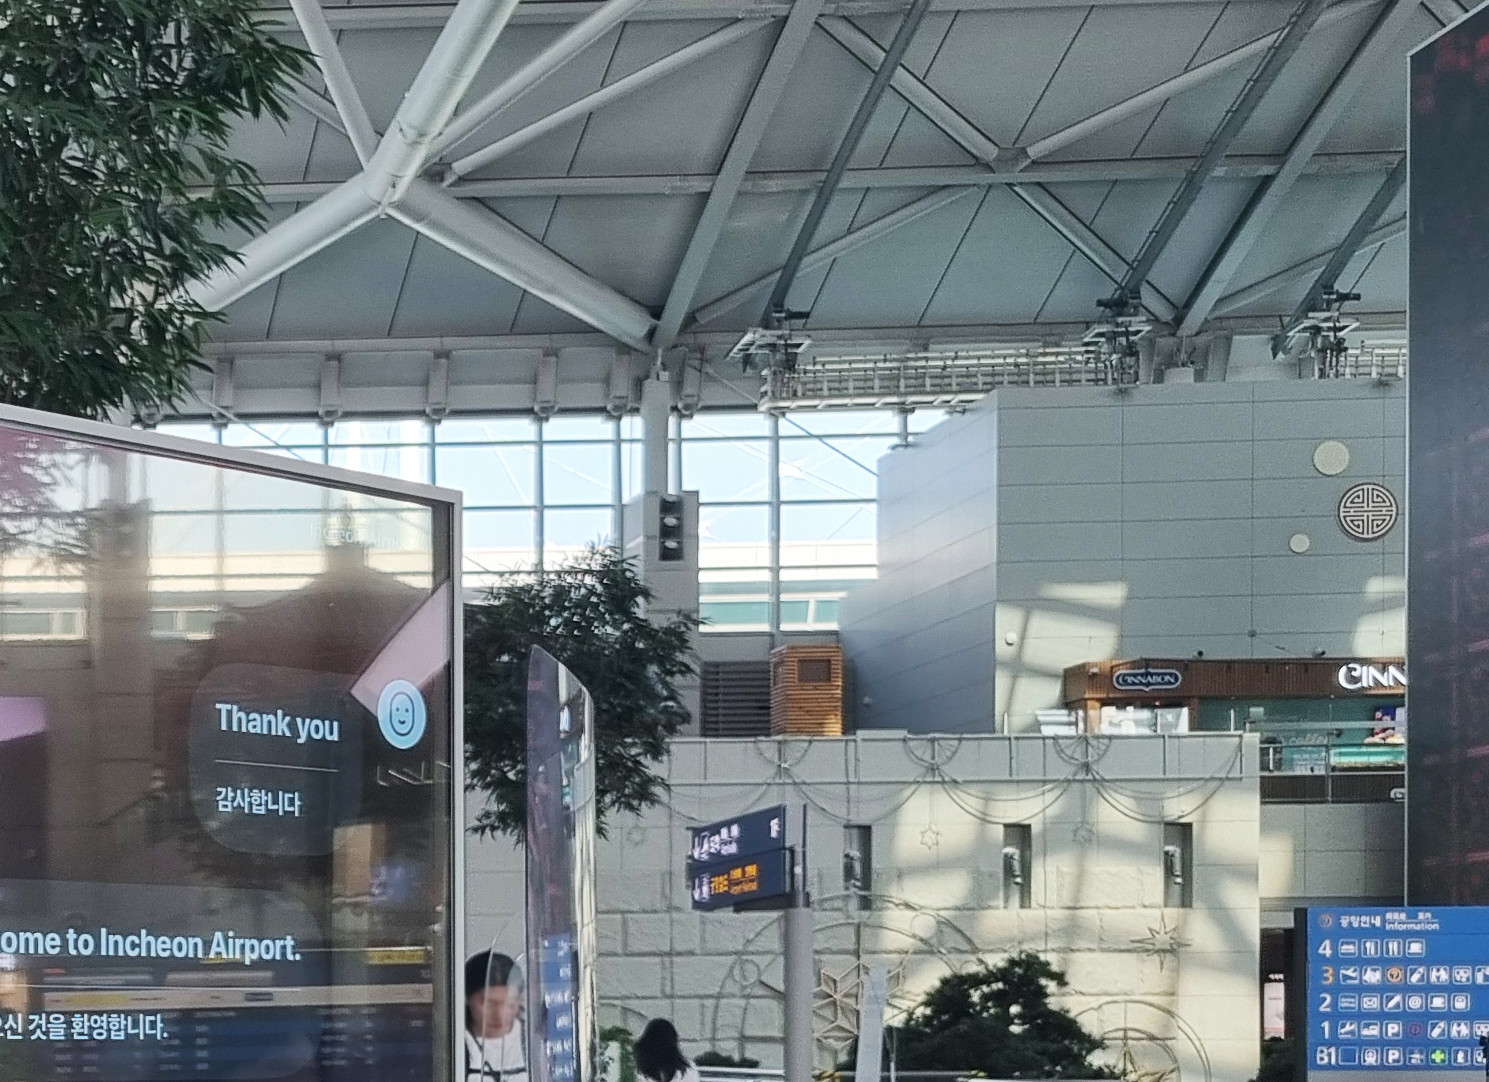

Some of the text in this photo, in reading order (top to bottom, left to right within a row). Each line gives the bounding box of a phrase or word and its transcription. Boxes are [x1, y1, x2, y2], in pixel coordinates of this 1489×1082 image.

[215, 702, 339, 744] Thank you
[216, 786, 302, 817] 감사합니다
[66, 928, 94, 956] to
[100, 928, 203, 958] Incheon
[209, 931, 302, 965] Airport.
[1318, 939, 1333, 958] 4
[1321, 965, 1335, 985] 3
[1318, 993, 1332, 1012] 2
[28, 1012, 67, 1040] 것을
[71, 1012, 169, 1041] 환영합니다.
[1320, 1021, 1330, 1040] 1
[1316, 1046, 1336, 1065] B1
